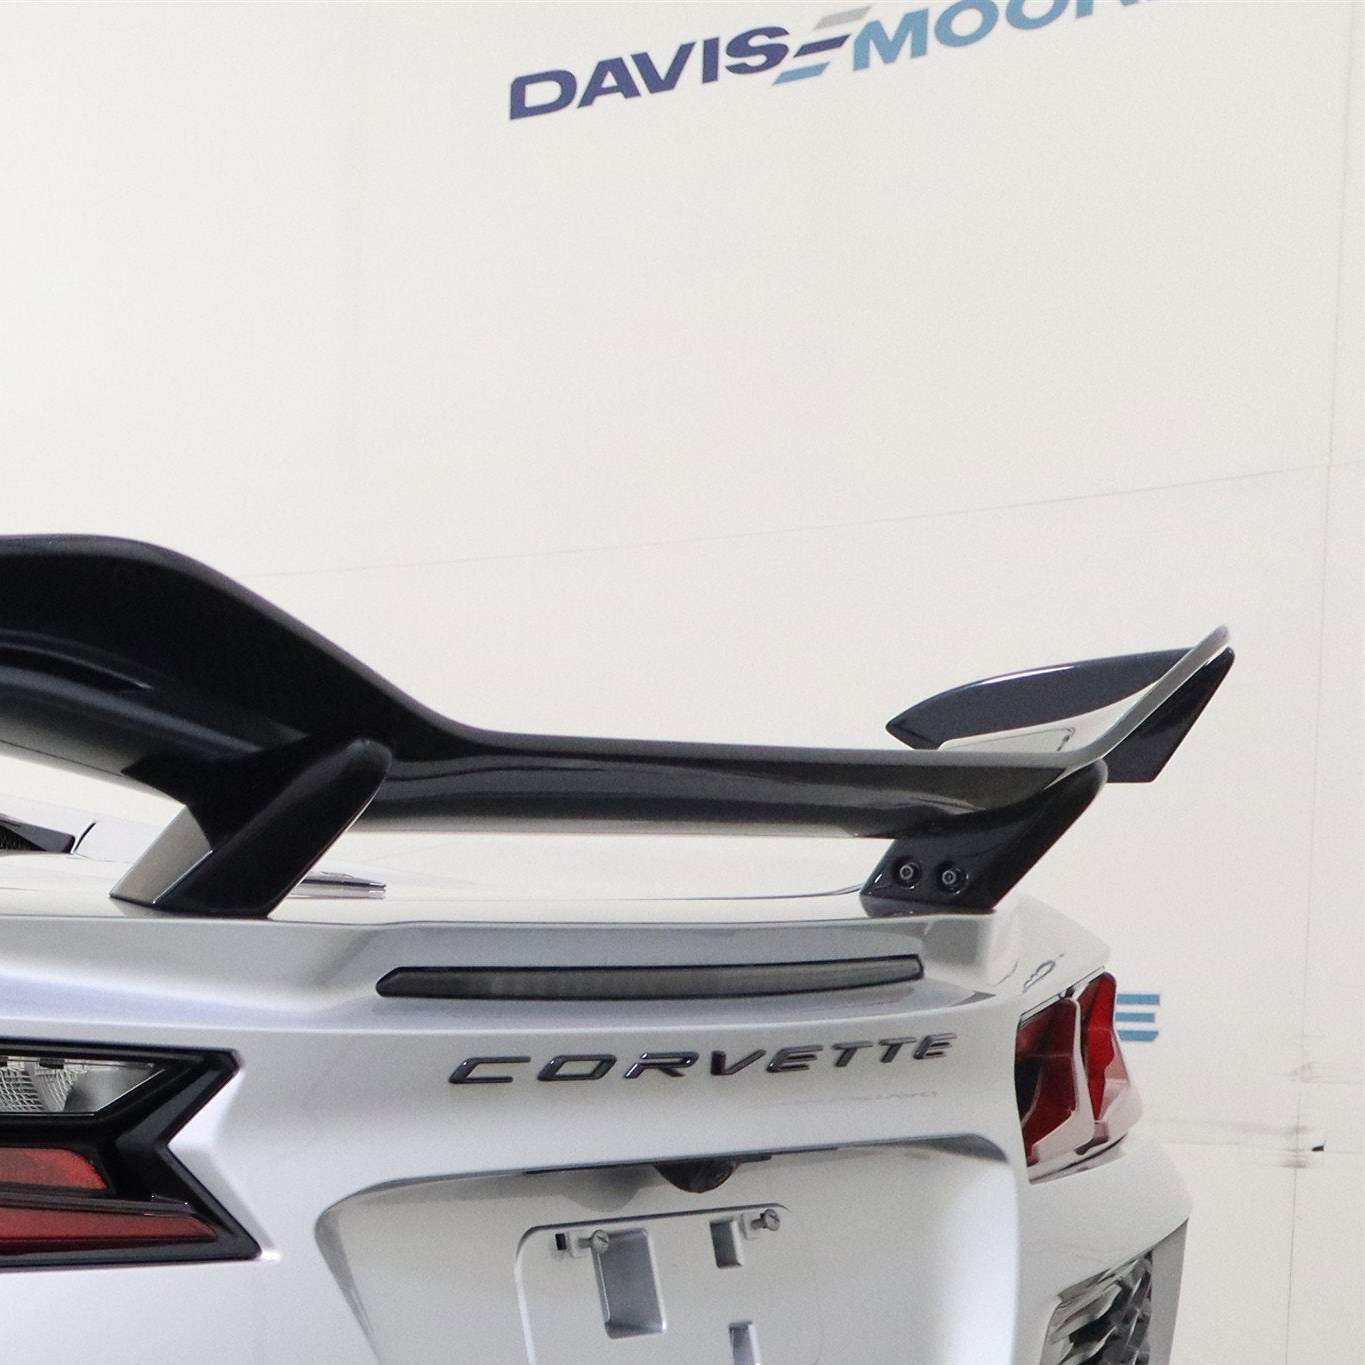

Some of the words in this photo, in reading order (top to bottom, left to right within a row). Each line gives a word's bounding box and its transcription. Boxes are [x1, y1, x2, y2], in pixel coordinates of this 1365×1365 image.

[509, 24, 791, 121] DAVIS
[853, 0, 1155, 72] MOO
[448, 1032, 957, 1084] CORVETTE
